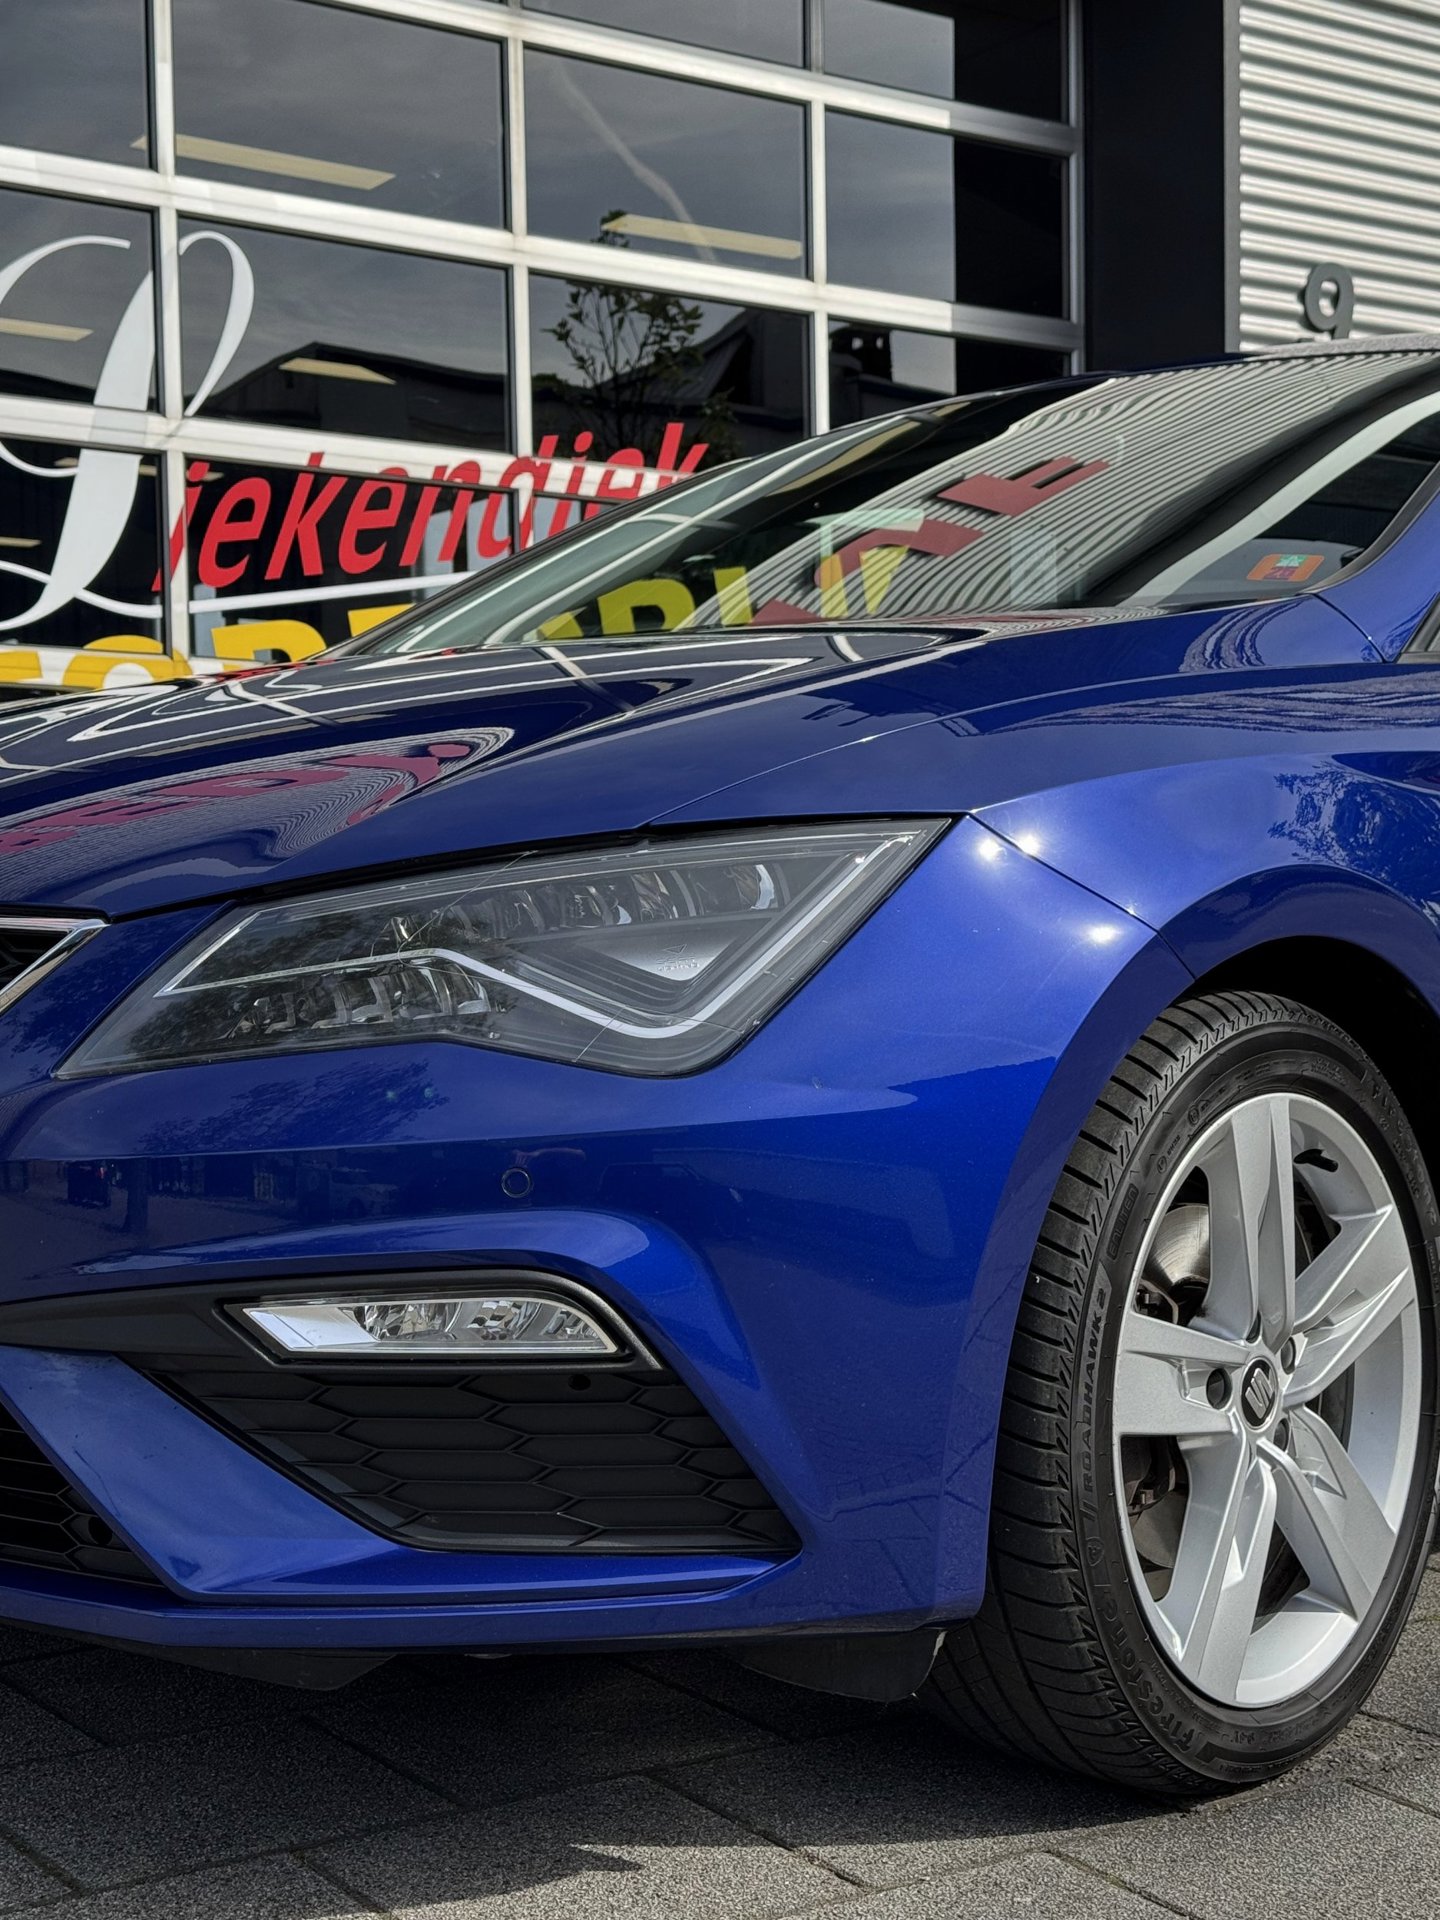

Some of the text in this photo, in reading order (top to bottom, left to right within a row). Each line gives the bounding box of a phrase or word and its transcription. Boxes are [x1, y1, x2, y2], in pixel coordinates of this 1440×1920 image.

[1305, 262, 1354, 340] 9
[1083, 1311, 1103, 1494] ROADHAWK
[1099, 1599, 1196, 1752] Firestone
